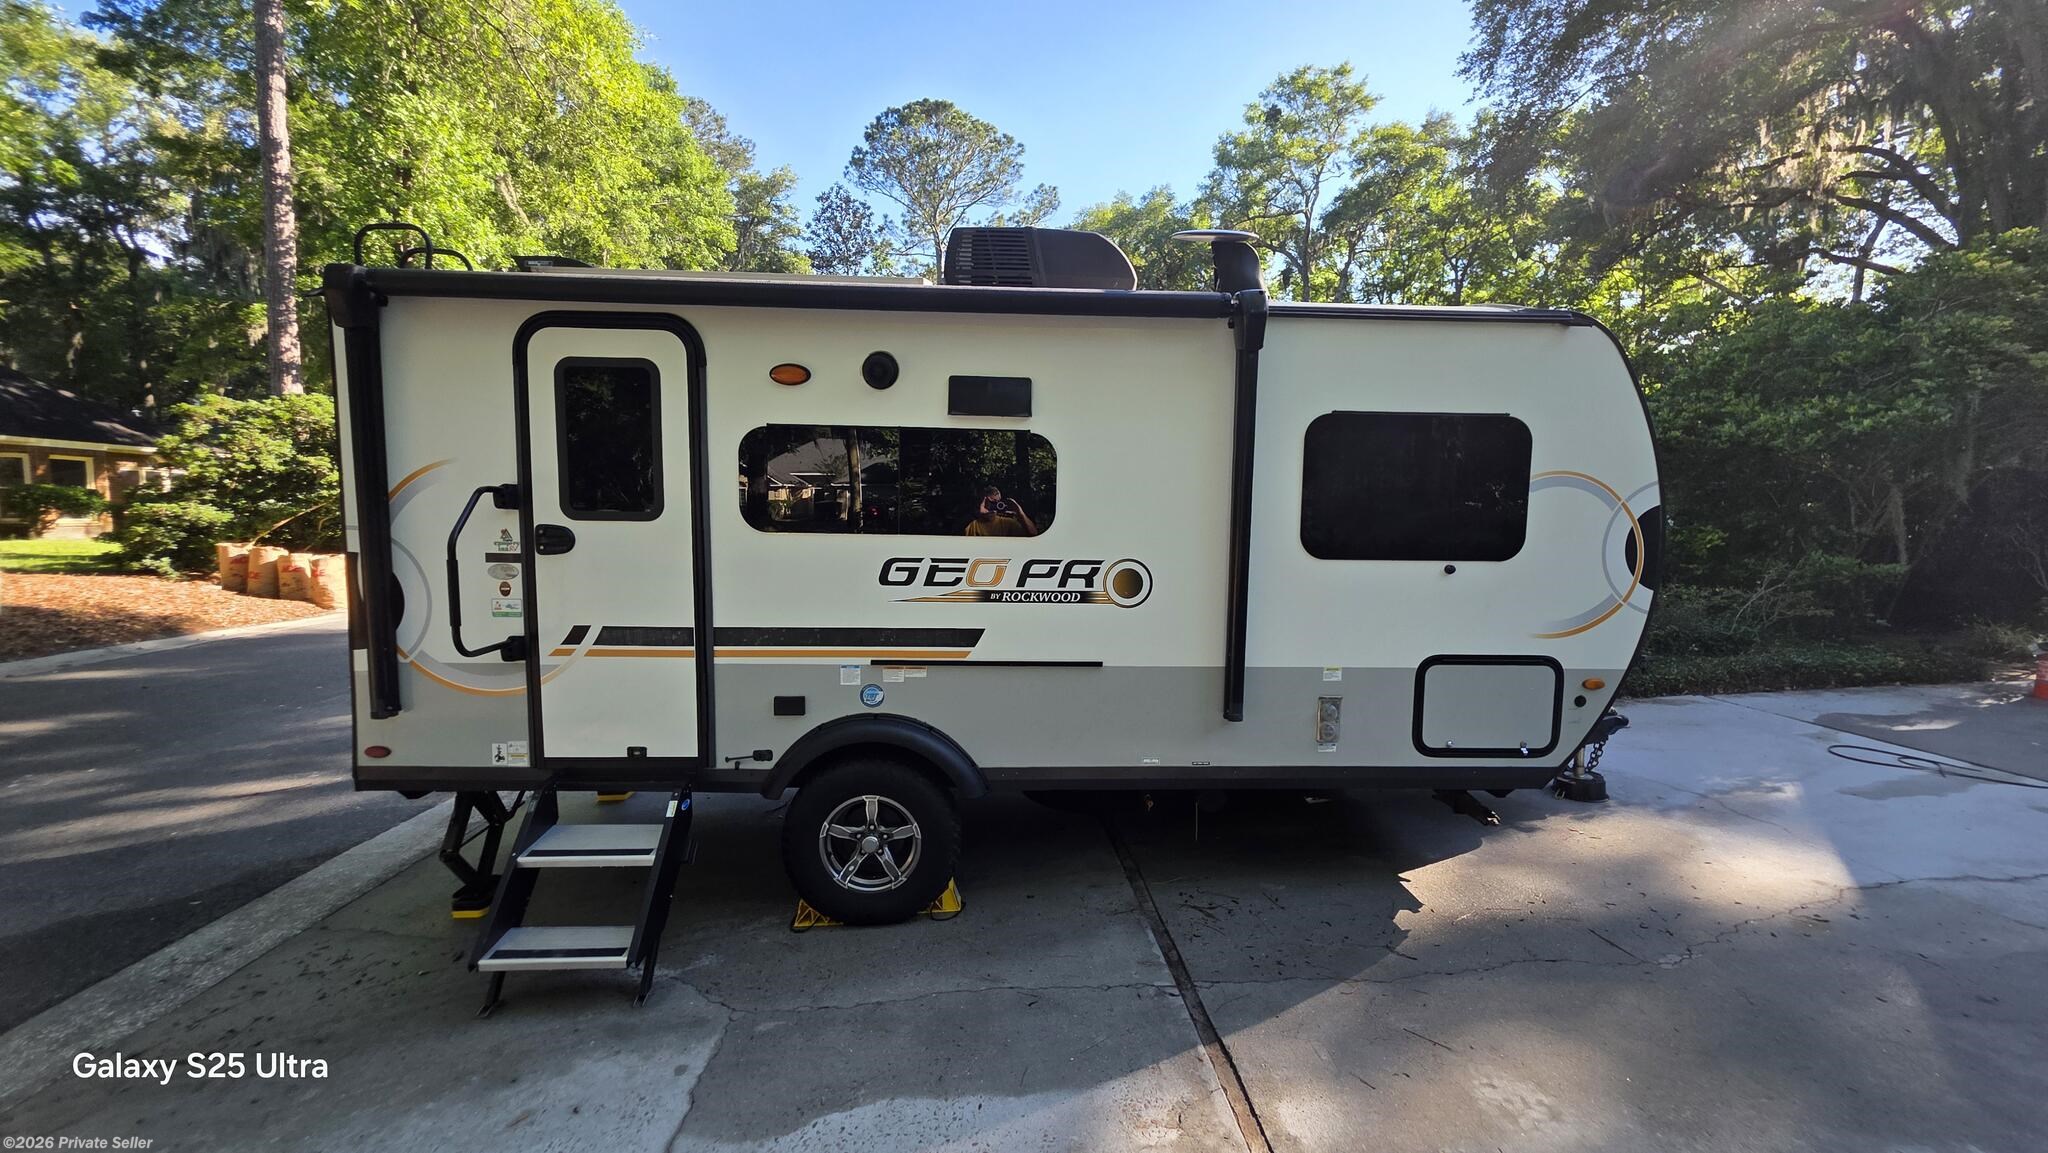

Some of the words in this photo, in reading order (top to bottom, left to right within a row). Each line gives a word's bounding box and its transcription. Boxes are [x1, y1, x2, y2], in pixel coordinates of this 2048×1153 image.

[878, 557, 1012, 588] GEO
[1015, 558, 1153, 608] PRO
[1001, 592, 1081, 602] ROCKWOOD
